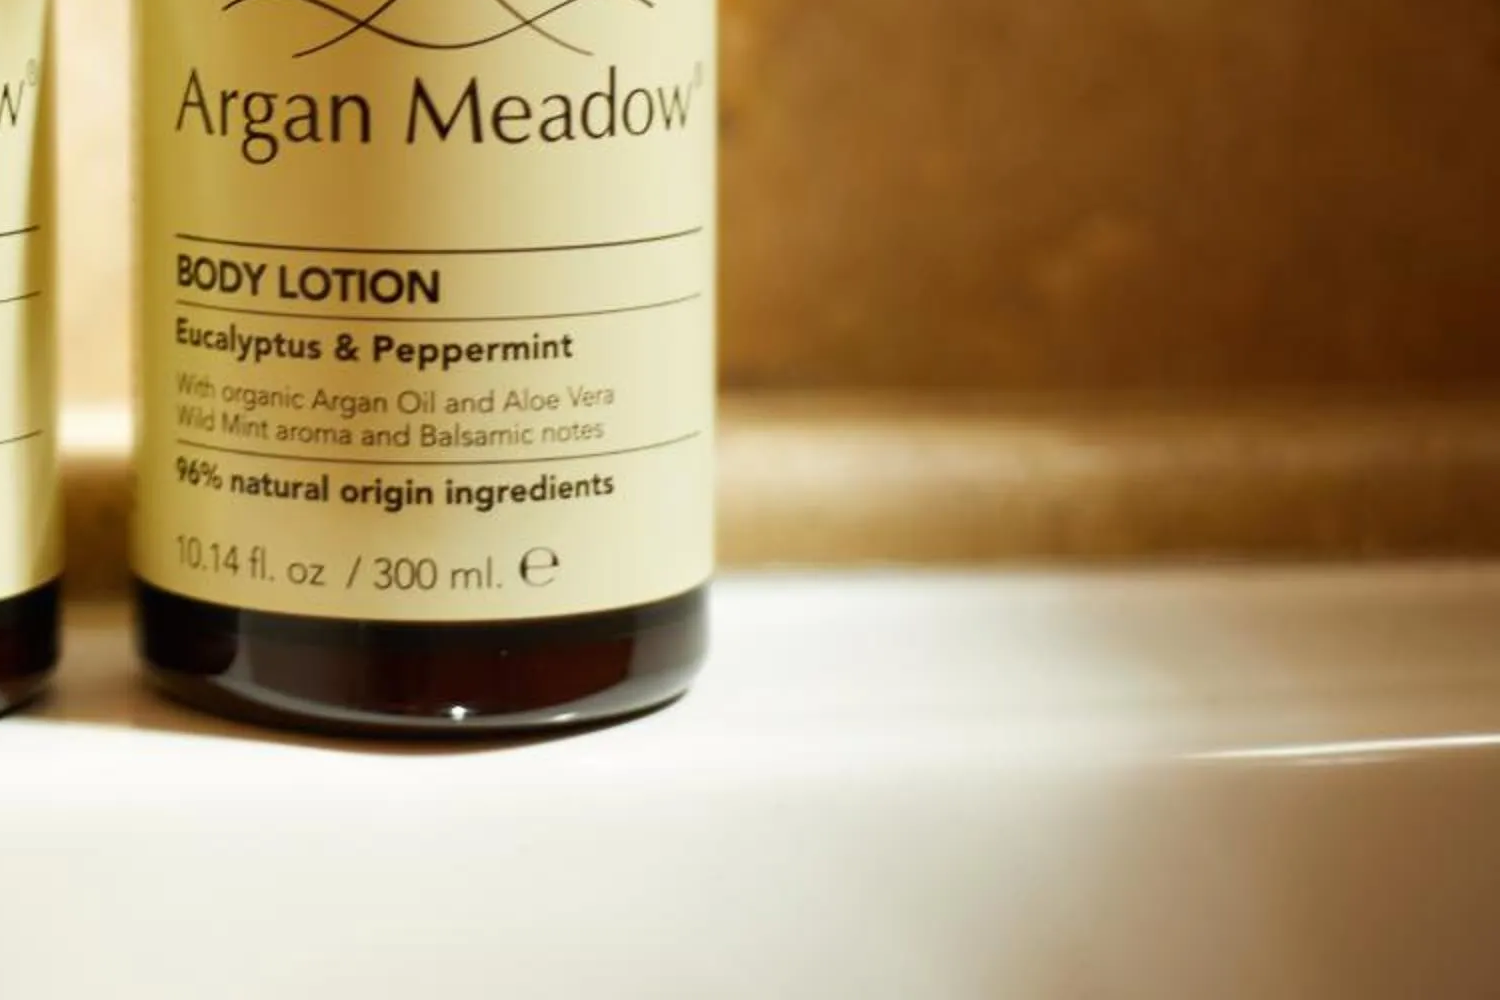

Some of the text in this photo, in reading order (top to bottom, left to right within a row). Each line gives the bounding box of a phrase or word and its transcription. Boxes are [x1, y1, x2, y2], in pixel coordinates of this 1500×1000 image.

[176, 68, 371, 165] Argan
[177, 254, 440, 304] BODY LOTION
[176, 315, 573, 371] Eucalyptus & Peppermint
[221, 385, 305, 411] organic
[311, 388, 388, 420] Argan
[397, 390, 435, 415] Oil
[444, 389, 495, 415] and
[502, 388, 560, 412] Aloe
[567, 385, 615, 407] Vera
[221, 410, 269, 440] Mint
[275, 419, 353, 446] aroma
[361, 423, 411, 448] and
[420, 422, 533, 448] Balsamic
[541, 422, 604, 441] notes
[176, 456, 614, 513] 96% natural origin ingredients
[287, 562, 325, 586] oz
[346, 555, 362, 589] /
[373, 557, 438, 591] 300
[450, 556, 502, 589] ml.
